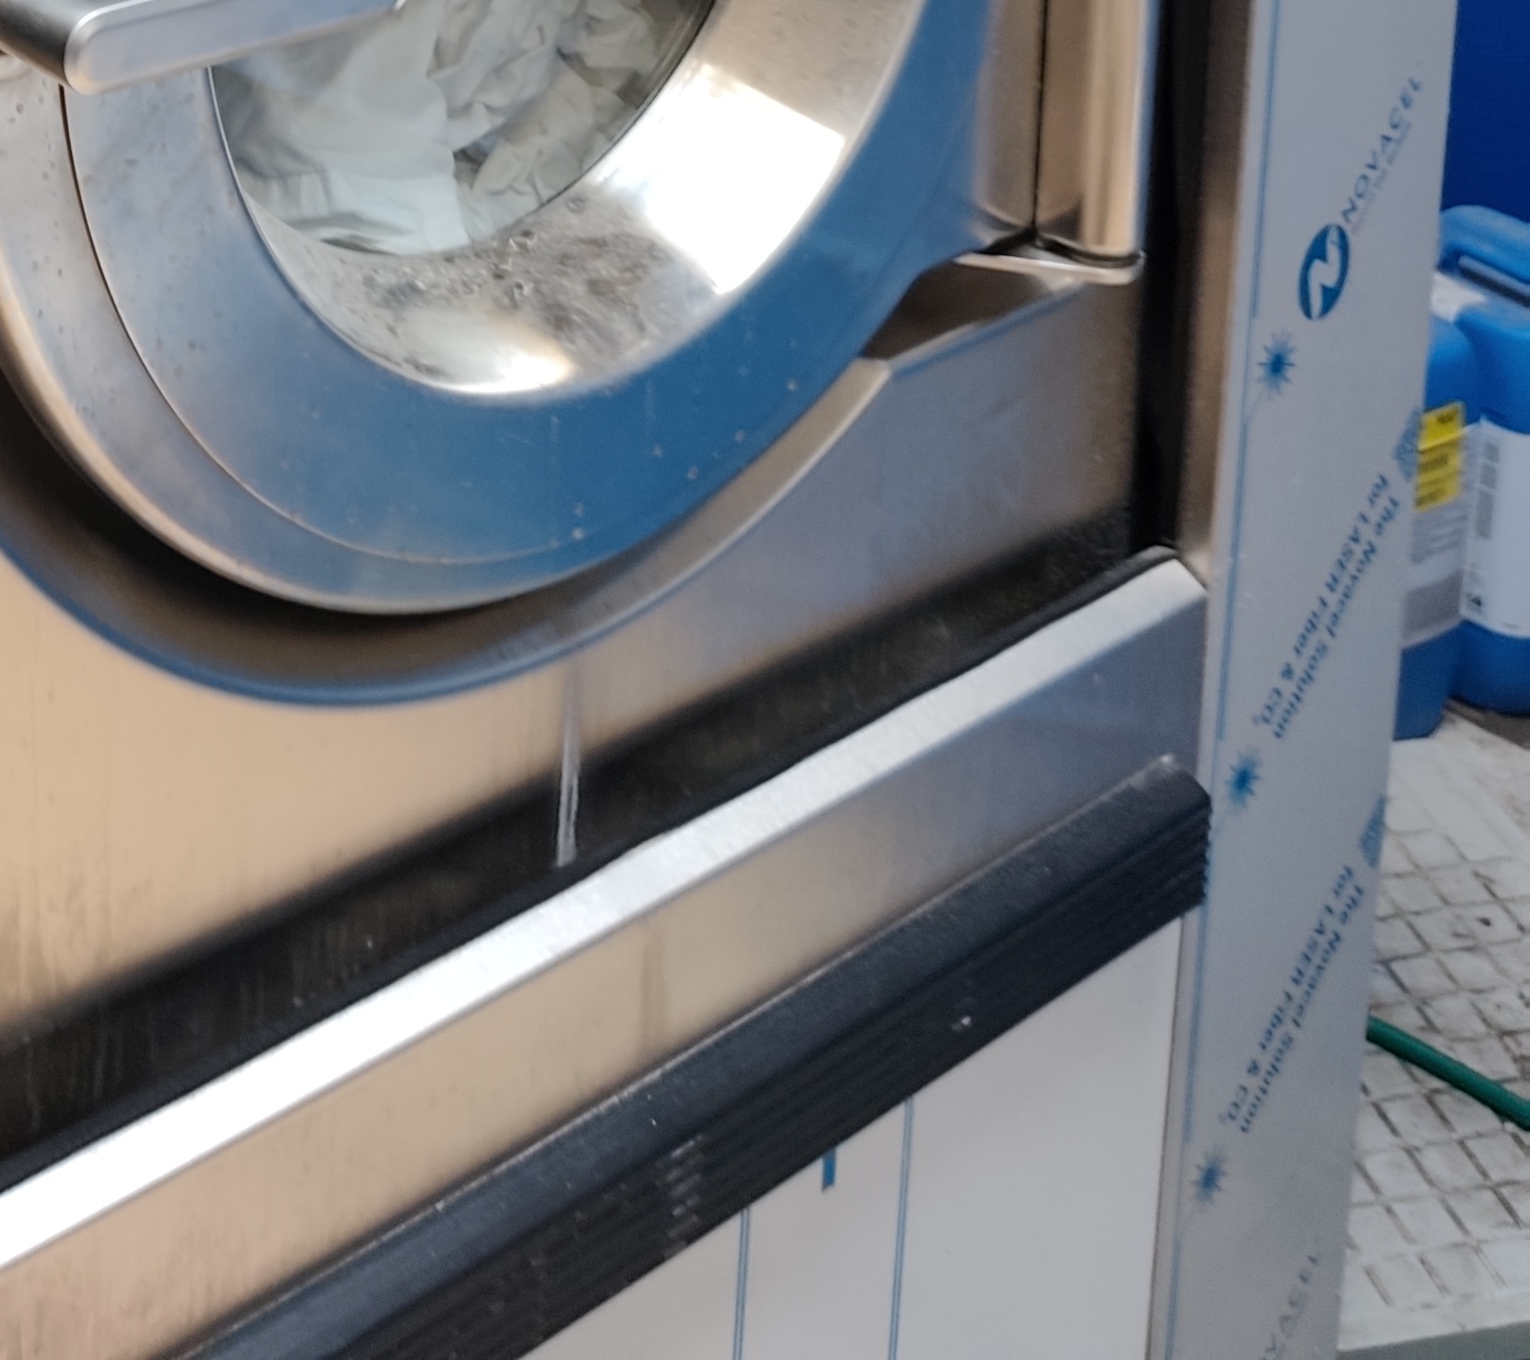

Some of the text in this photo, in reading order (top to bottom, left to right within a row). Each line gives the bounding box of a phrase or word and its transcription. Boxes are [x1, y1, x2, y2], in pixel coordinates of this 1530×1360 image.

[1341, 76, 1422, 224] NOVACEL
[1368, 473, 1390, 507] for
[1325, 511, 1371, 594] LASER
[1273, 495, 1400, 740] The Novacel Solution
[1293, 595, 1329, 657] Fiber
[1334, 863, 1355, 898] for
[1289, 903, 1335, 987] LASER
[1239, 884, 1366, 1134] The Novacel Solution
[1258, 988, 1294, 1052] Fiber
